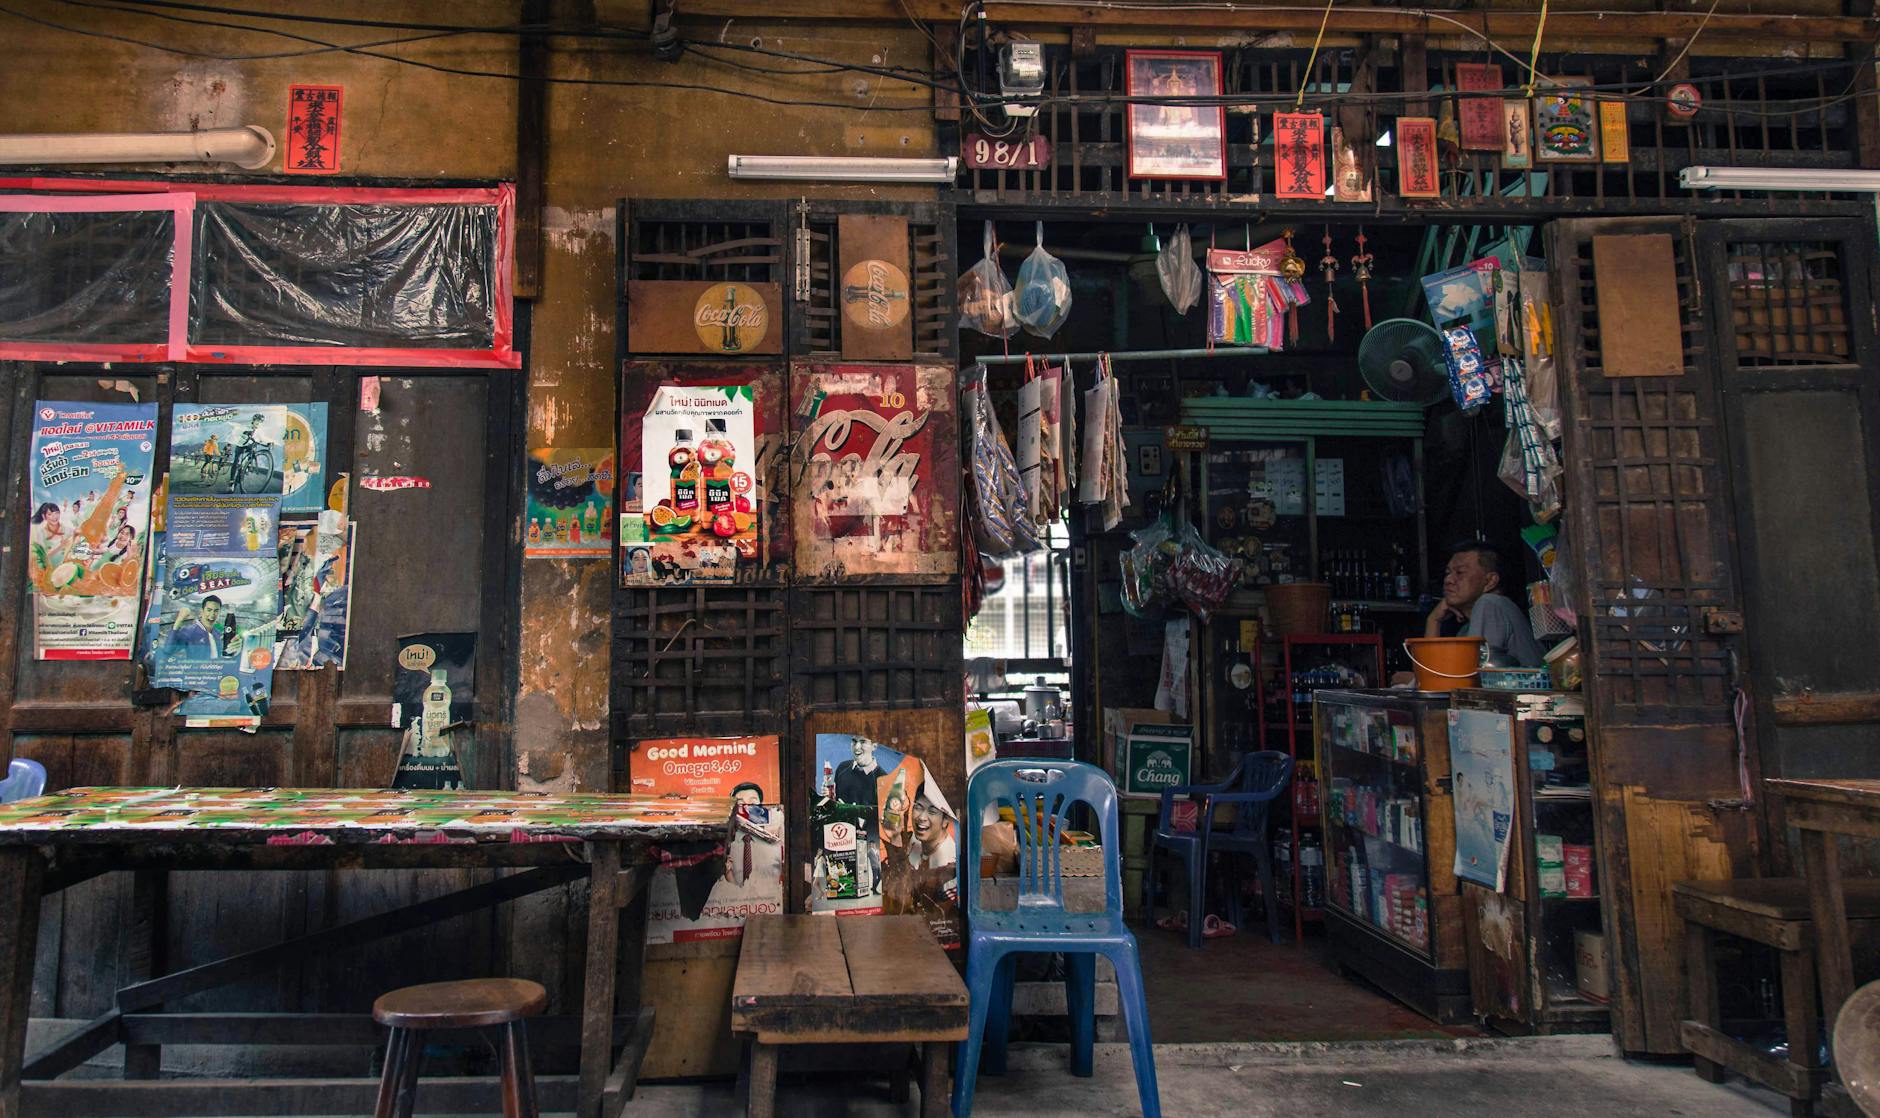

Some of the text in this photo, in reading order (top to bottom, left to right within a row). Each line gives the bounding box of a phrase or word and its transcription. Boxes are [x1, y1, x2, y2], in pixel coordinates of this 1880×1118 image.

[975, 139, 1038, 166] 98/1
[1233, 255, 1271, 268] Lucky
[879, 393, 906, 408] 10
[85, 420, 155, 433] @VITAMILK
[732, 476, 748, 488] 15
[200, 577, 231, 591] SEAT
[404, 649, 429, 660] ใหม่!
[647, 742, 756, 760] Good Morning
[1137, 768, 1181, 786] Chang
